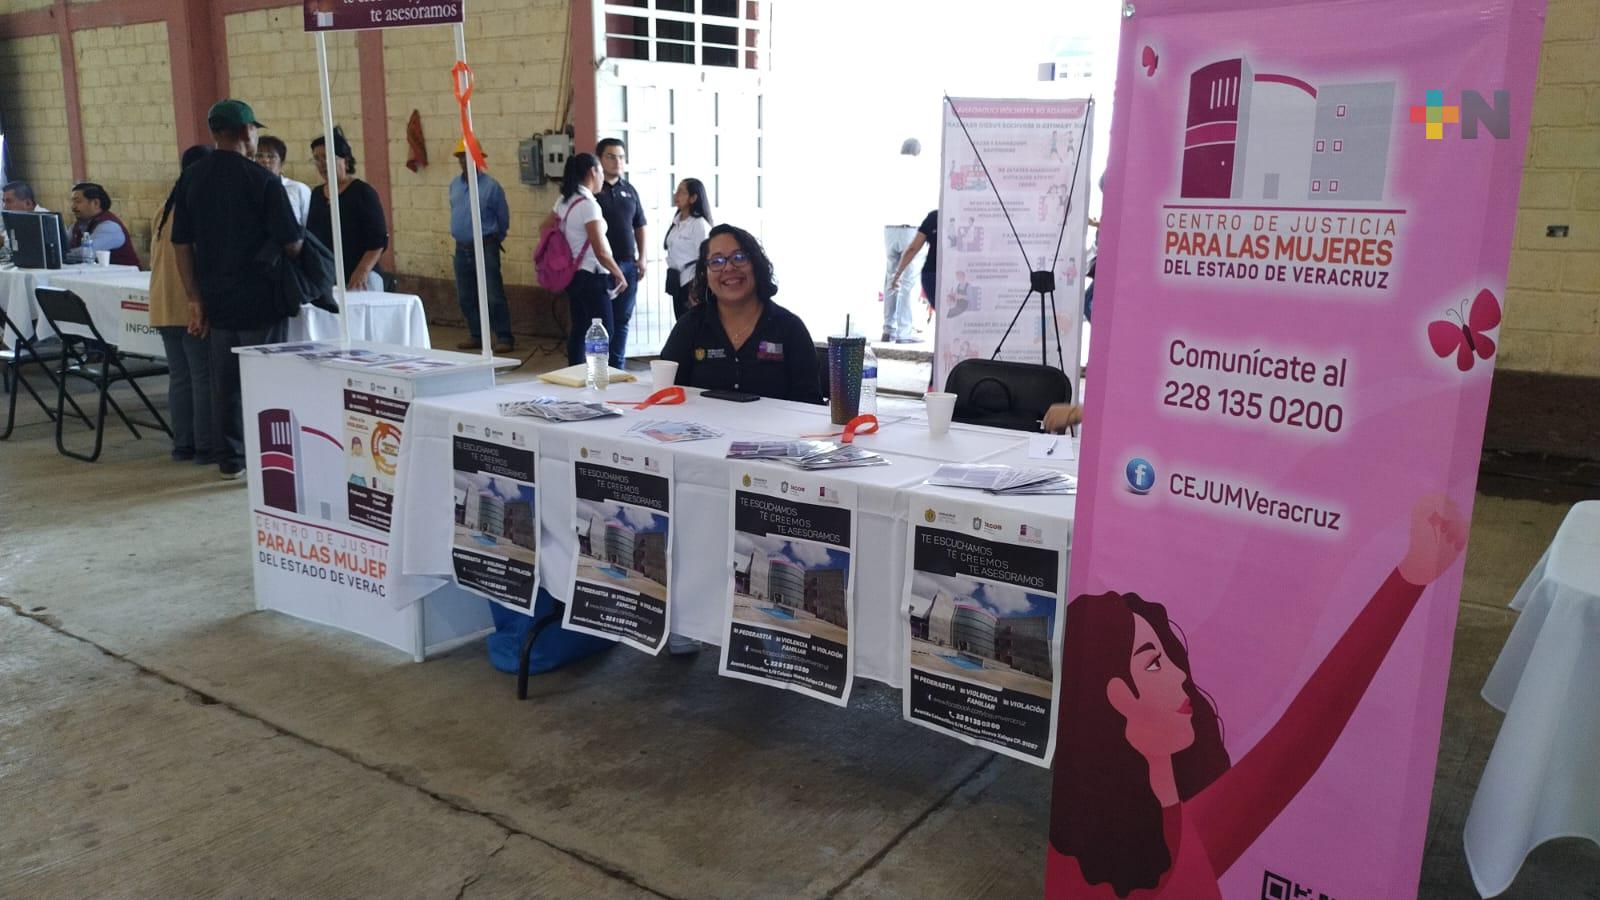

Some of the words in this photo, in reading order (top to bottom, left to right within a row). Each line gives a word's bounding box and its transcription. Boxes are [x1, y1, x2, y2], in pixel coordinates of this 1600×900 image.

[371, 8, 382, 22] te
[385, 4, 457, 21] asesoramos
[1166, 213, 1242, 230] CENTRO
[1254, 216, 1278, 232] DE
[1290, 216, 1396, 236] JUSTICIA
[1166, 232, 1222, 258] PARA
[1225, 234, 1270, 260] LAS
[1274, 236, 1393, 266] MUJERES
[1164, 258, 1192, 276] DEL
[1197, 261, 1258, 280] ESTADO
[1266, 264, 1286, 282] DE
[1293, 267, 1389, 289] VERACRUZ
[1170, 340, 1316, 384] Comunícate
[1322, 358, 1346, 388] al
[1164, 380, 1210, 411] 228
[1218, 388, 1262, 420] 135
[1269, 396, 1344, 432] 0200
[588, 469, 629, 484] ESCUCHAMOS
[607, 481, 640, 494] CREEMOS
[740, 497, 749, 506] TE
[750, 499, 798, 516] ESCUCHAMOS
[1170, 474, 1341, 530] CEJUMVeracruz
[256, 516, 308, 539] CENTRO
[316, 530, 333, 545] DE
[760, 511, 768, 521] TE
[770, 512, 811, 528] CREEMOS
[776, 525, 785, 534] TE
[788, 526, 841, 543] ASESORAMOS
[921, 534, 932, 544] TE
[934, 535, 992, 557] ESCUCHAMOS
[258, 530, 296, 556] PARA
[299, 541, 330, 564] LAS
[947, 550, 957, 559] TE
[960, 551, 1009, 570] CREEMOS
[260, 552, 278, 567] DEL
[280, 556, 326, 580] ESTADO
[330, 569, 345, 584] DE
[348, 574, 386, 598] VERAC
[969, 564, 980, 574] TE
[981, 568, 1044, 588] ASESORAMOS
[739, 628, 772, 640] PEDERASTIA
[782, 637, 808, 648] VIOLENCIA
[782, 646, 806, 655] FAMILIAR
[920, 676, 955, 692] PEDERASTIA
[966, 689, 998, 703] VIOLENCIA
[1010, 700, 1045, 714] VIOLACIÓN
[967, 697, 996, 710] FAMILIAR
